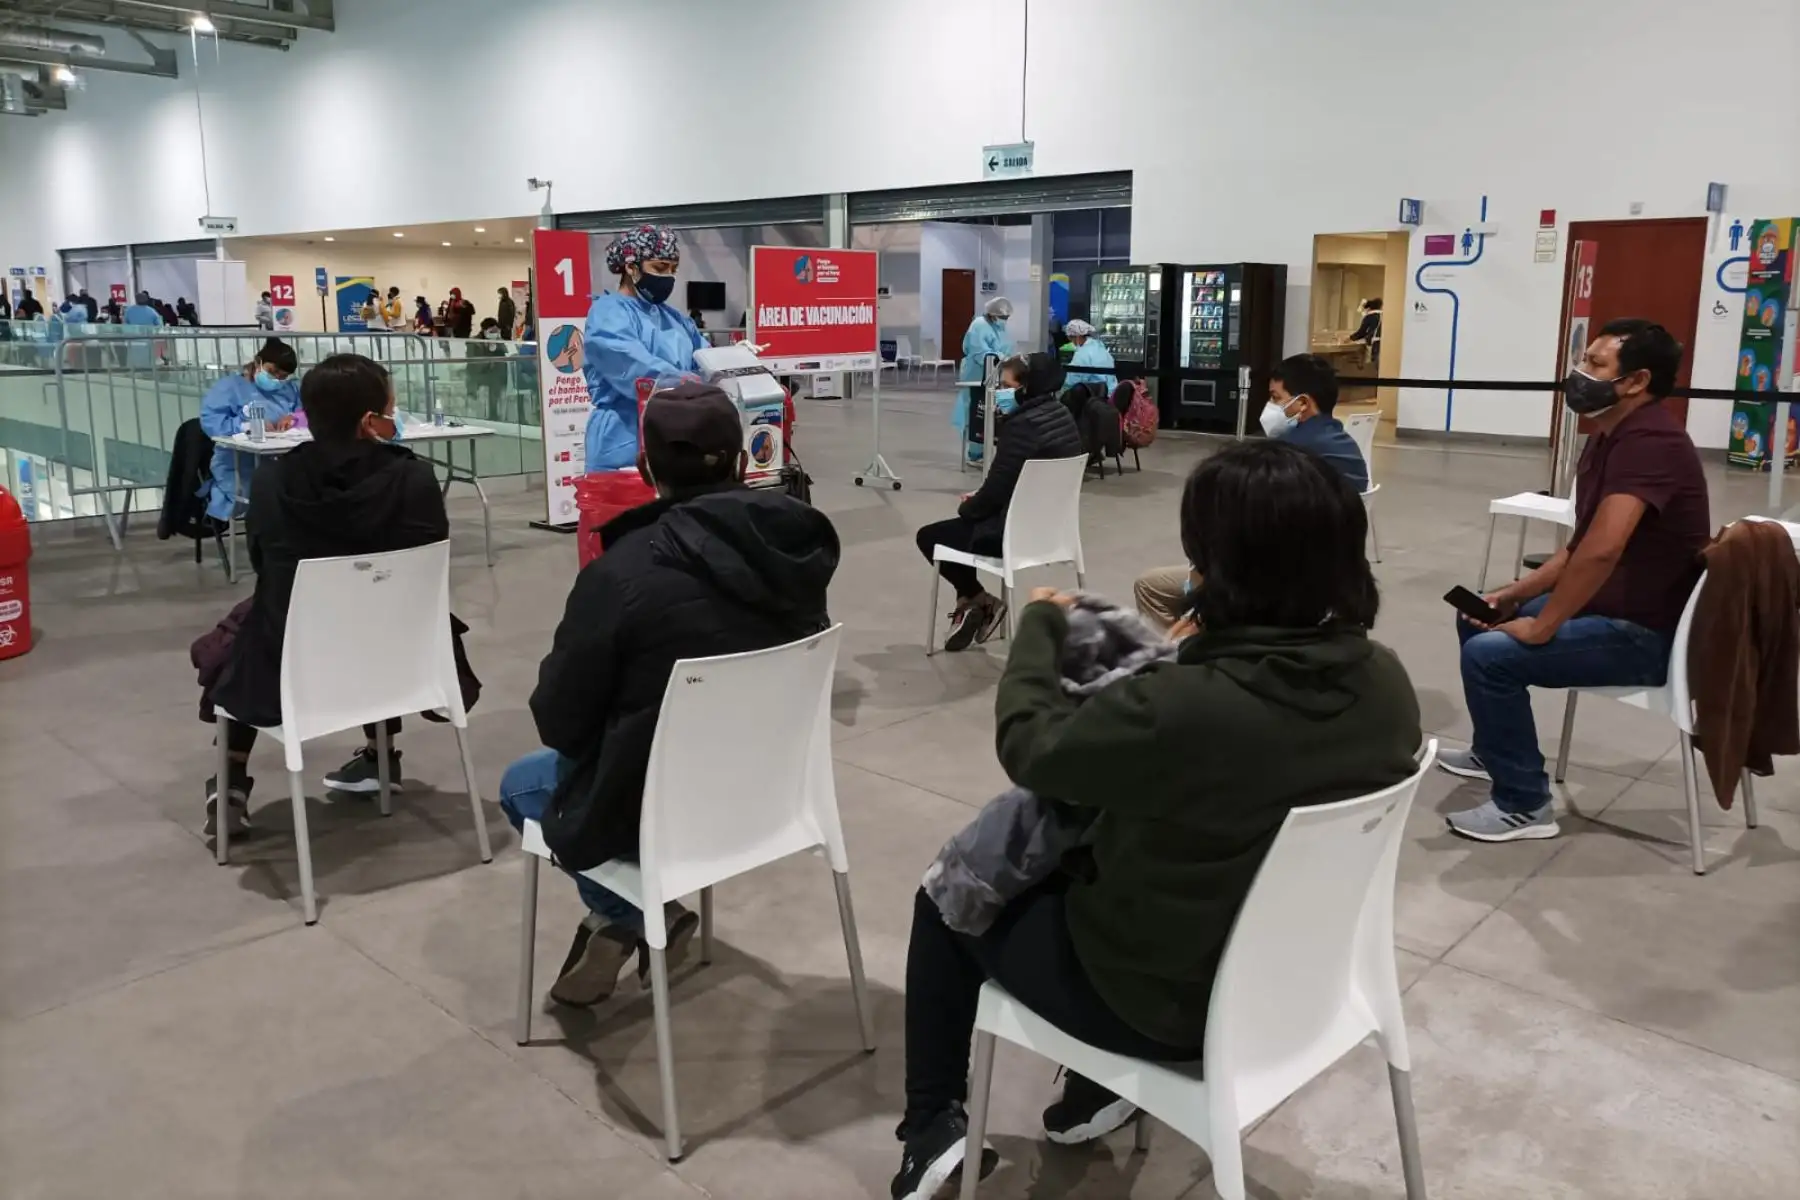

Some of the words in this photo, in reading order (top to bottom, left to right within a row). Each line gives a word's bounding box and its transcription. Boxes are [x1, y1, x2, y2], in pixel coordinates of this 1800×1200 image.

[1003, 157, 1028, 167] SALIDA
[554, 258, 574, 296] 1
[1578, 264, 1594, 298] 13
[272, 285, 294, 299] 12
[758, 304, 788, 327] ÁREA
[790, 307, 804, 326] DE
[806, 302, 873, 325] VACUNACIÓN
[549, 397, 564, 408] por
[564, 395, 571, 404] el
